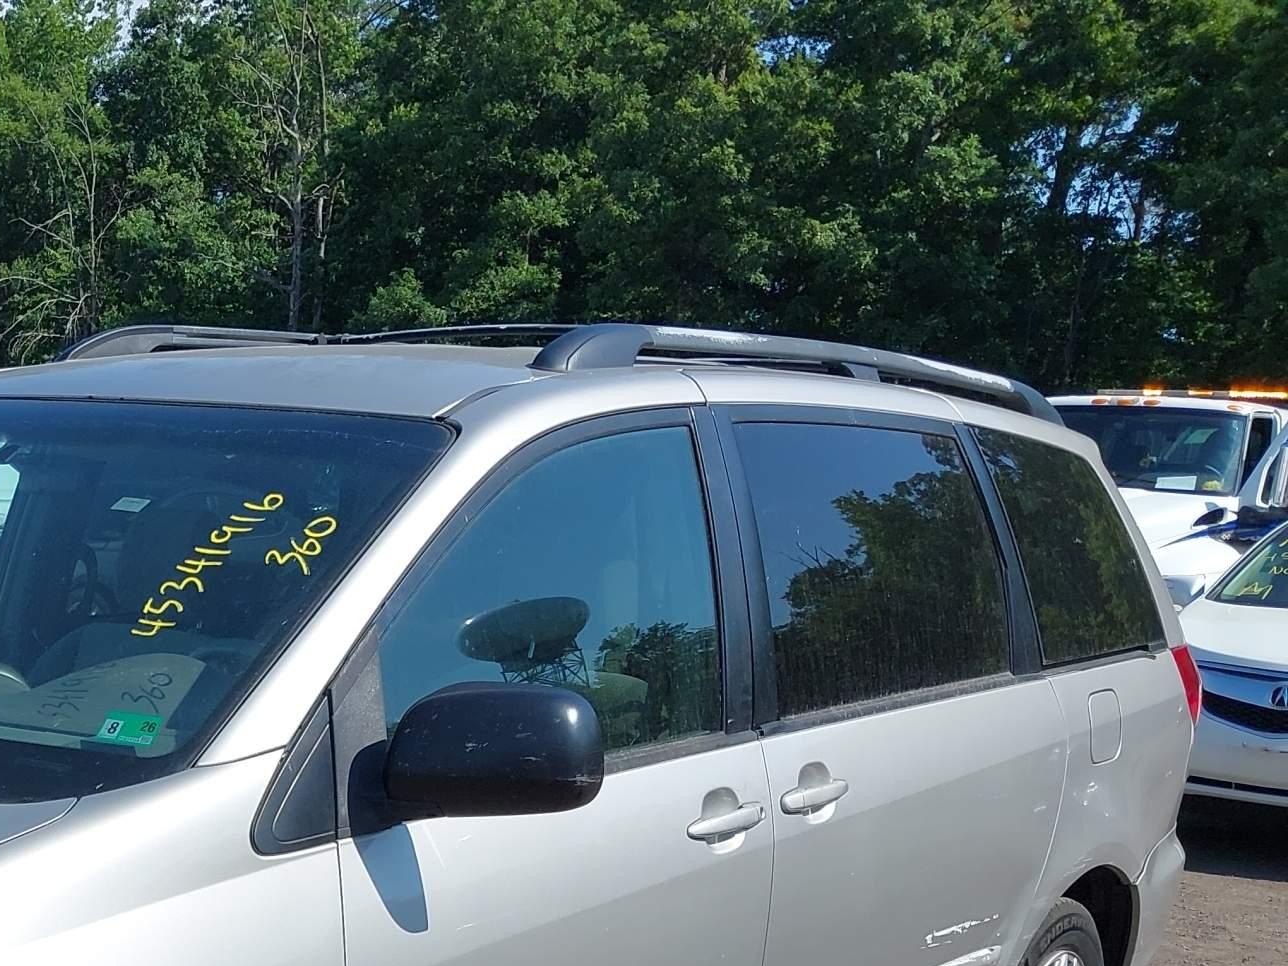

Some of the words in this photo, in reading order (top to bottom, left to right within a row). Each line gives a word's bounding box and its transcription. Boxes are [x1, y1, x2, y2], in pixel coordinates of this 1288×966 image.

[131, 492, 285, 638] 45341916
[265, 515, 338, 577] 360
[107, 721, 120, 735] 8
[140, 720, 158, 733] 26
